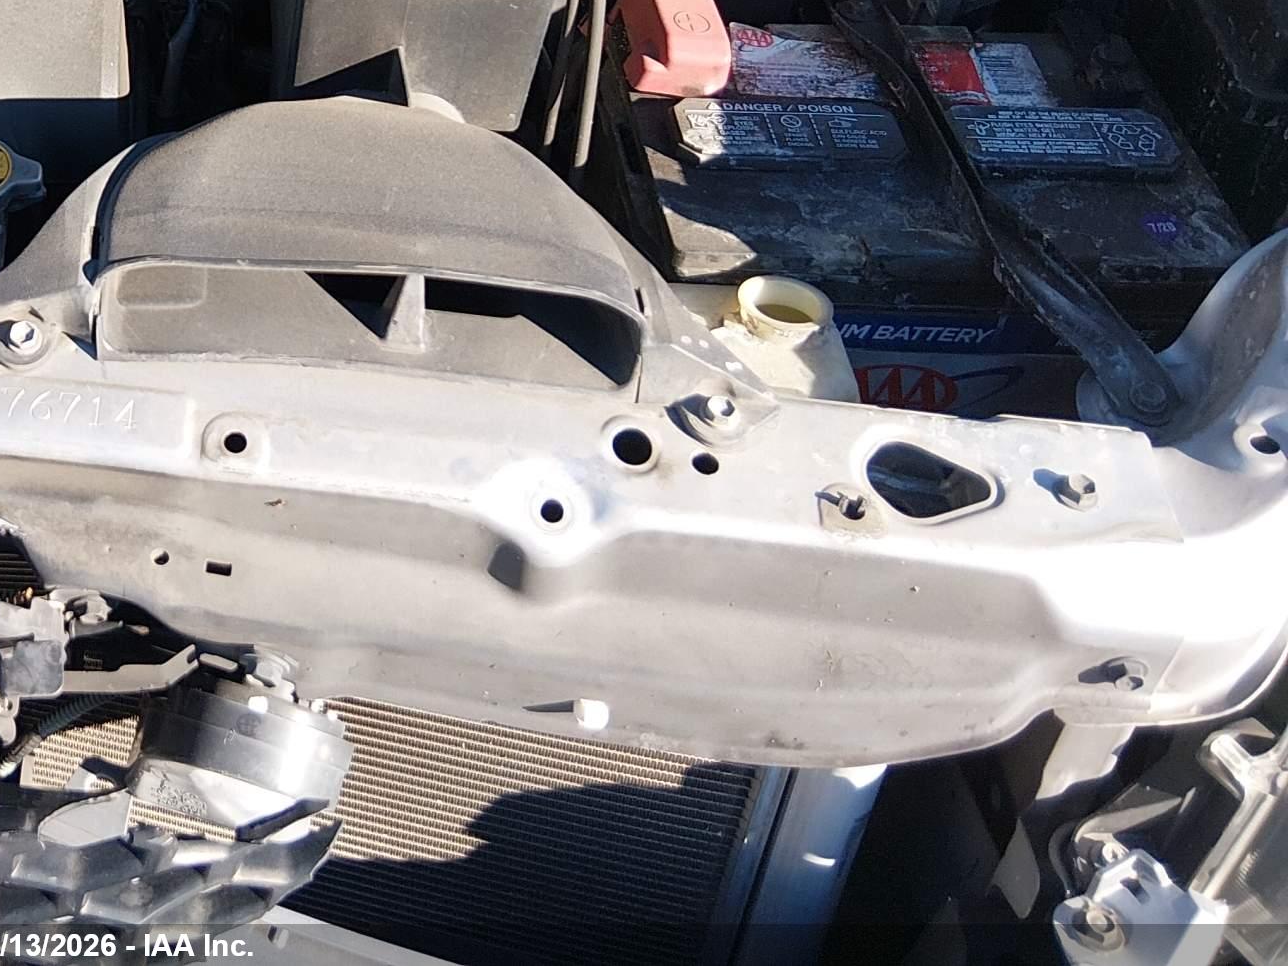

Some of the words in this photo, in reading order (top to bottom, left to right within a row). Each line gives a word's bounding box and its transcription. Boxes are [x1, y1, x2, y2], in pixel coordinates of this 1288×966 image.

[737, 29, 771, 46] AAA
[723, 102, 783, 113] DANGER
[786, 104, 793, 112] /
[799, 103, 854, 114] POISON
[871, 325, 995, 343] BATTERY
[0, 386, 137, 430] 76714
